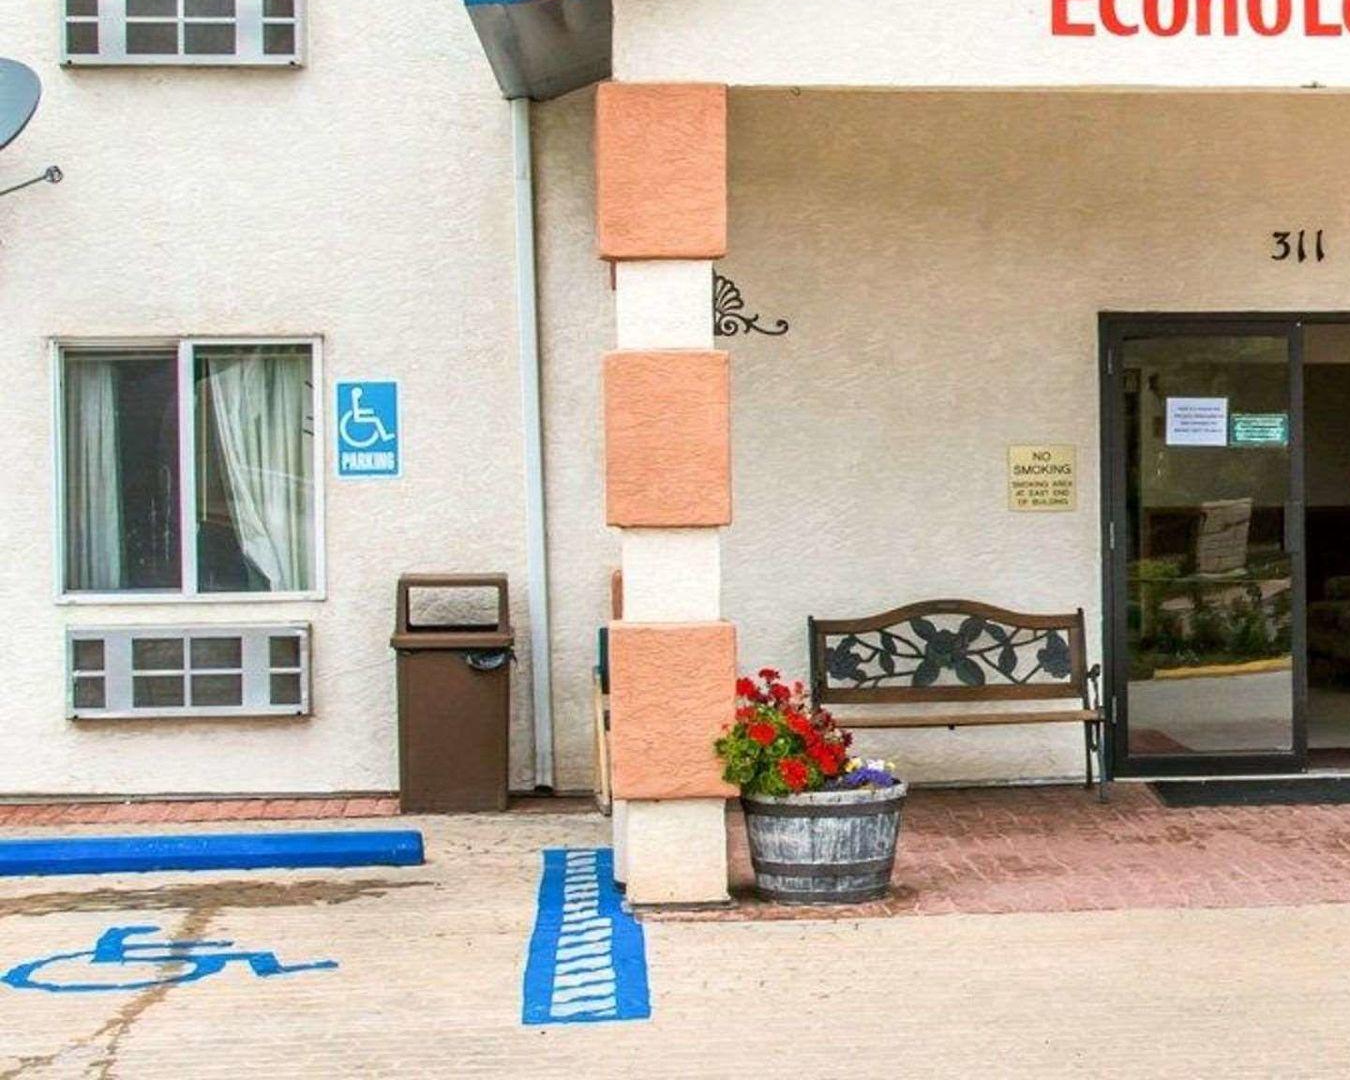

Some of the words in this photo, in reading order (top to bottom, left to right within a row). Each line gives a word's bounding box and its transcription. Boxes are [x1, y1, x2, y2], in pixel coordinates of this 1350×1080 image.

[1271, 229, 1325, 262] 311
[341, 451, 396, 471] PARKING
[1032, 451, 1051, 461] NO
[1012, 463, 1072, 475] SMOKING
